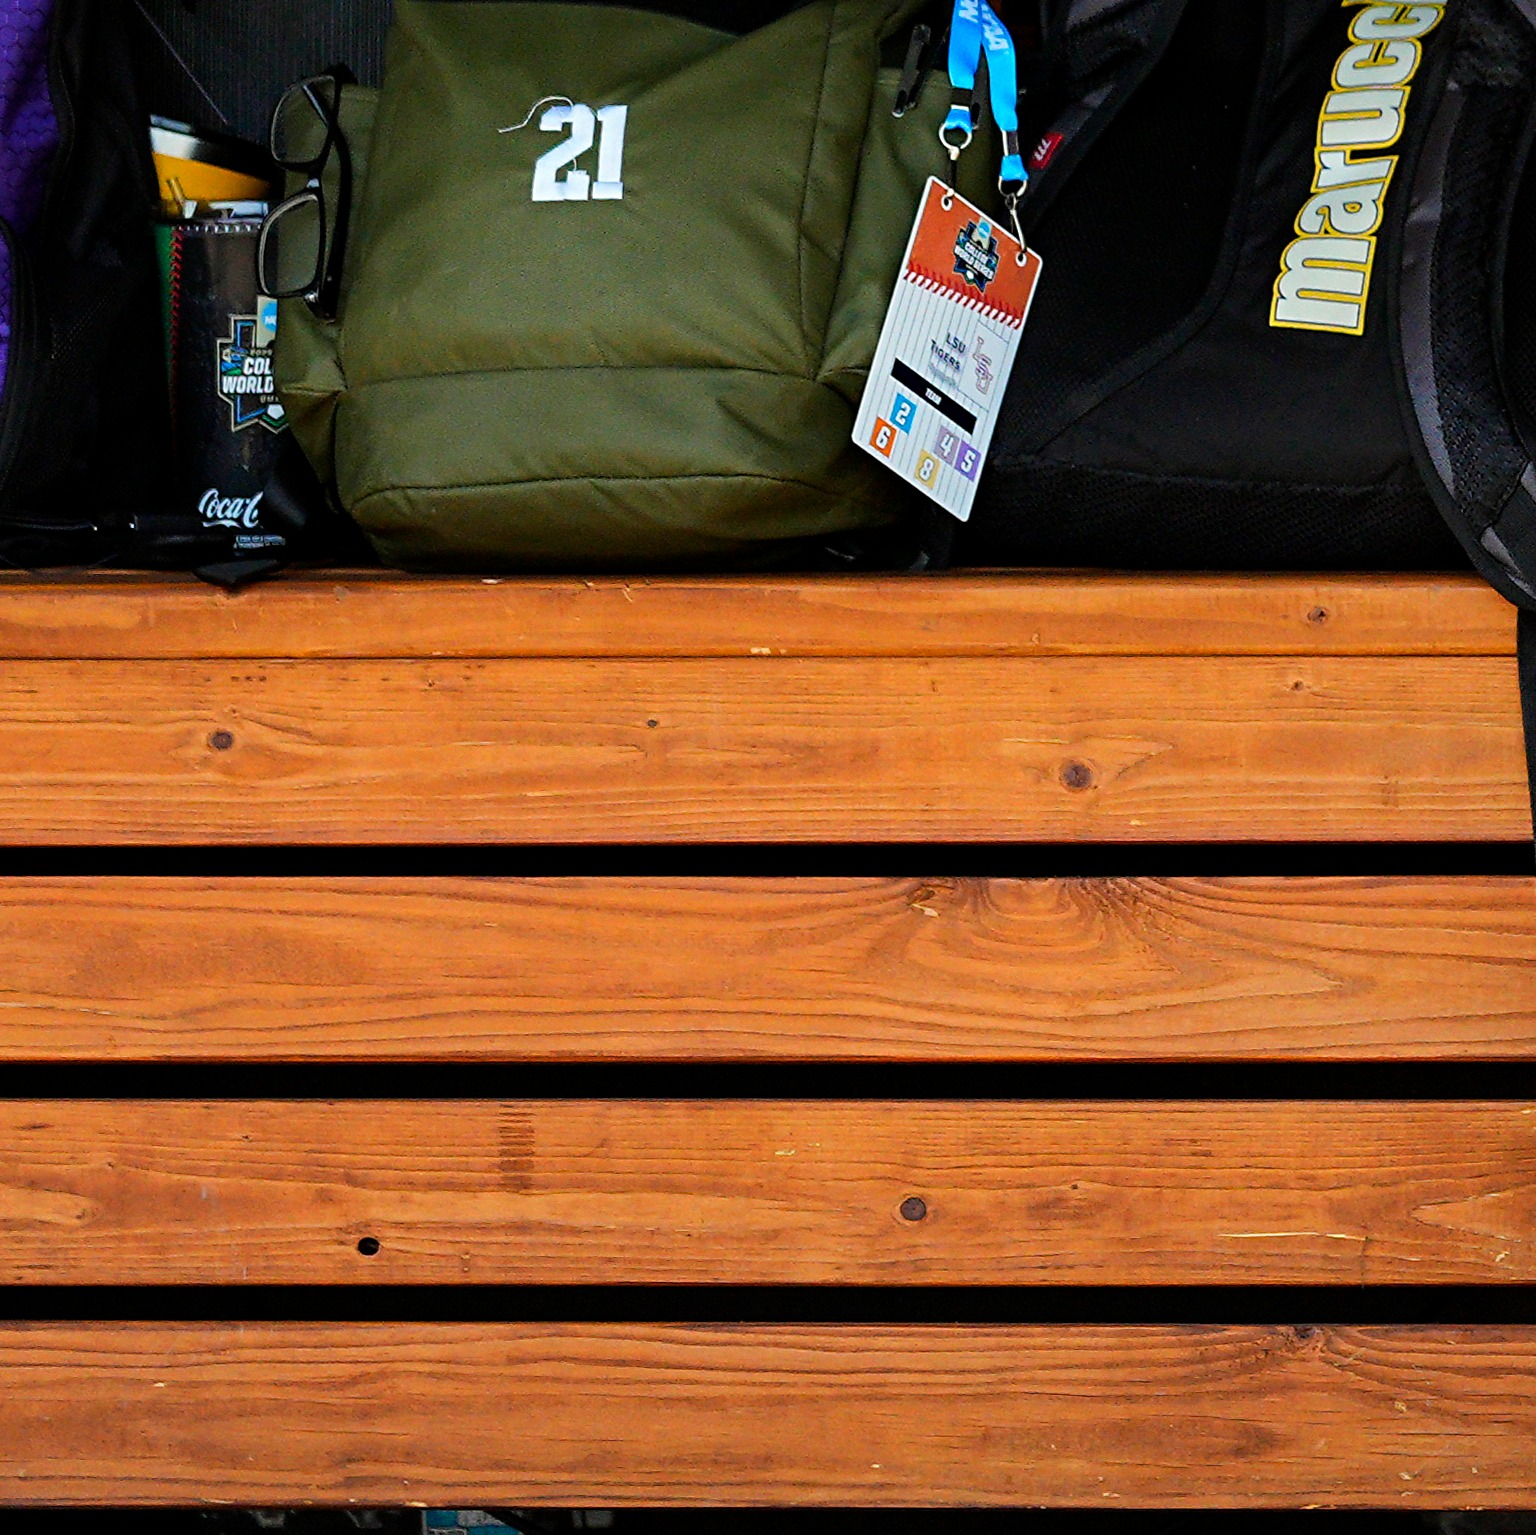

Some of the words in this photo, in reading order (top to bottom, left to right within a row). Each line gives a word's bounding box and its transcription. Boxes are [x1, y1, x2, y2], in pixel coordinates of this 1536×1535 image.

[531, 103, 629, 203] 21
[945, 332, 967, 354] LSU
[897, 402, 911, 425] 2
[875, 425, 891, 449] 6
[940, 432, 953, 458] 4
[961, 445, 976, 472] 5
[919, 457, 935, 481] 8
